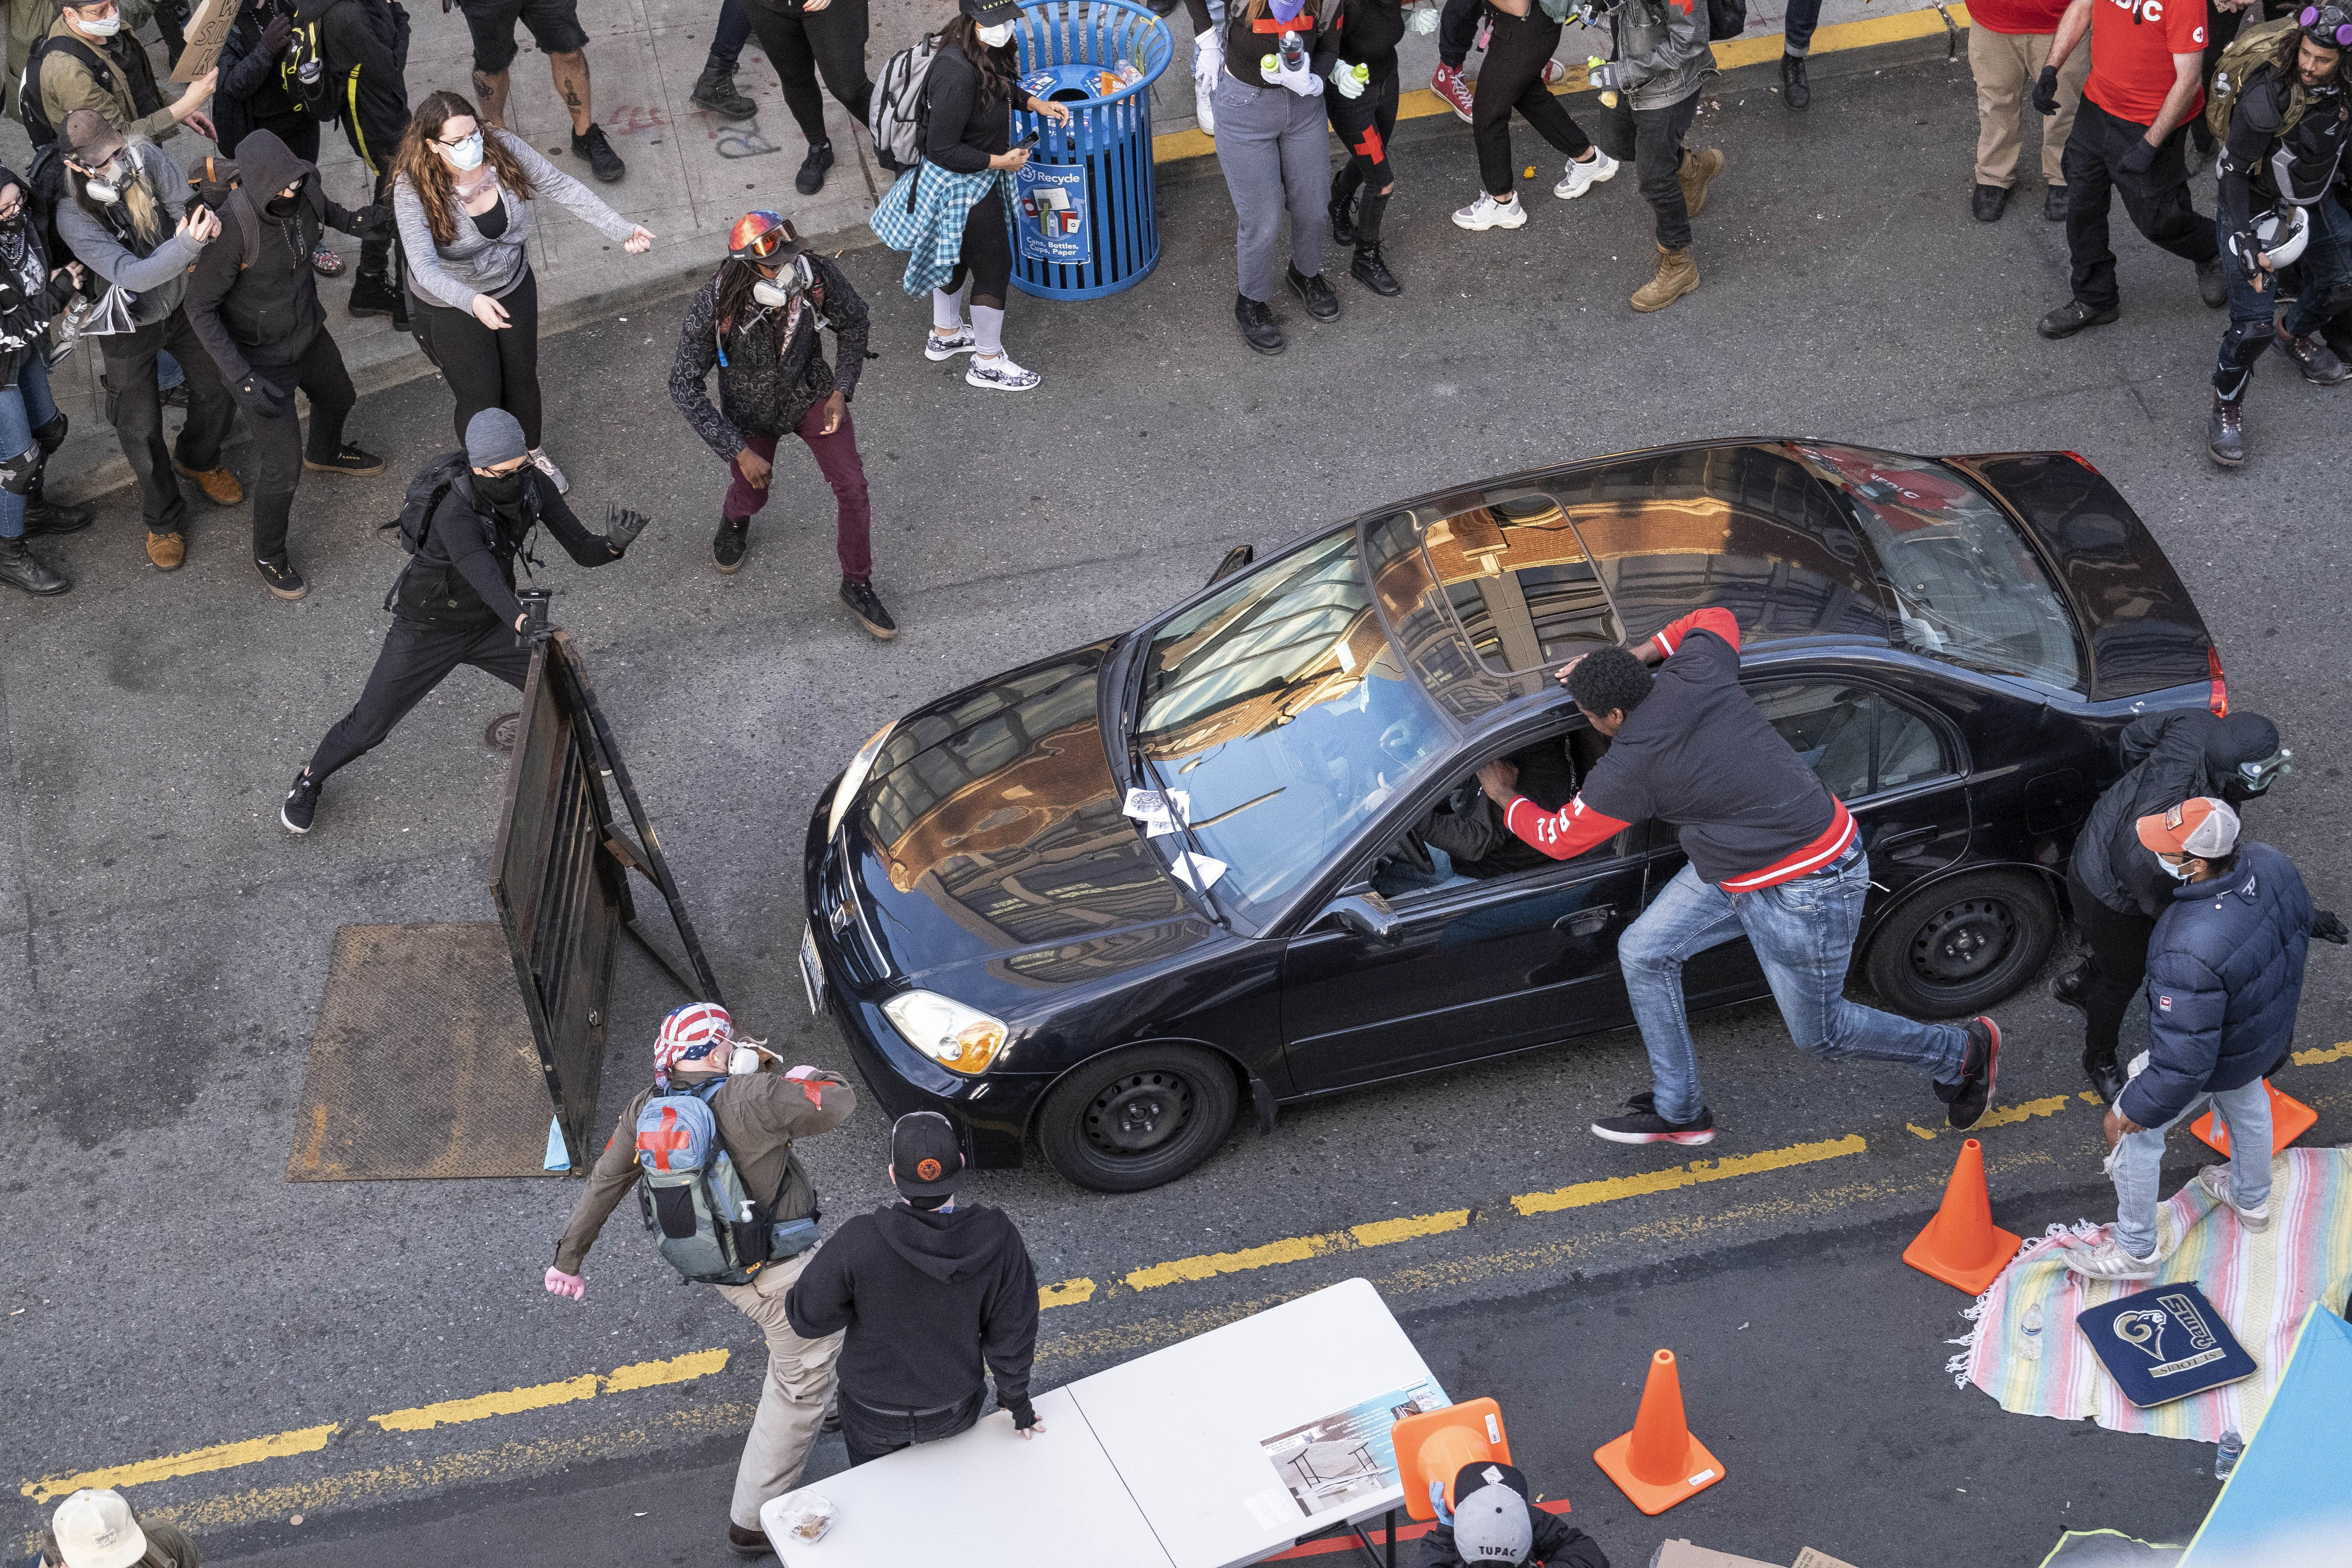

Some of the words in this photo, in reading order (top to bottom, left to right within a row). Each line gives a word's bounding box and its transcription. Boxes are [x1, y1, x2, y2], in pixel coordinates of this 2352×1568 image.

[1037, 172, 1080, 185] Recycle
[1026, 236, 1046, 247] Cans,
[1048, 241, 1079, 250] Bottles,
[1030, 244, 1050, 254] Cups,
[2160, 1358, 2198, 1372] LOUIS
[1478, 1546, 1517, 1557] TUPAC
